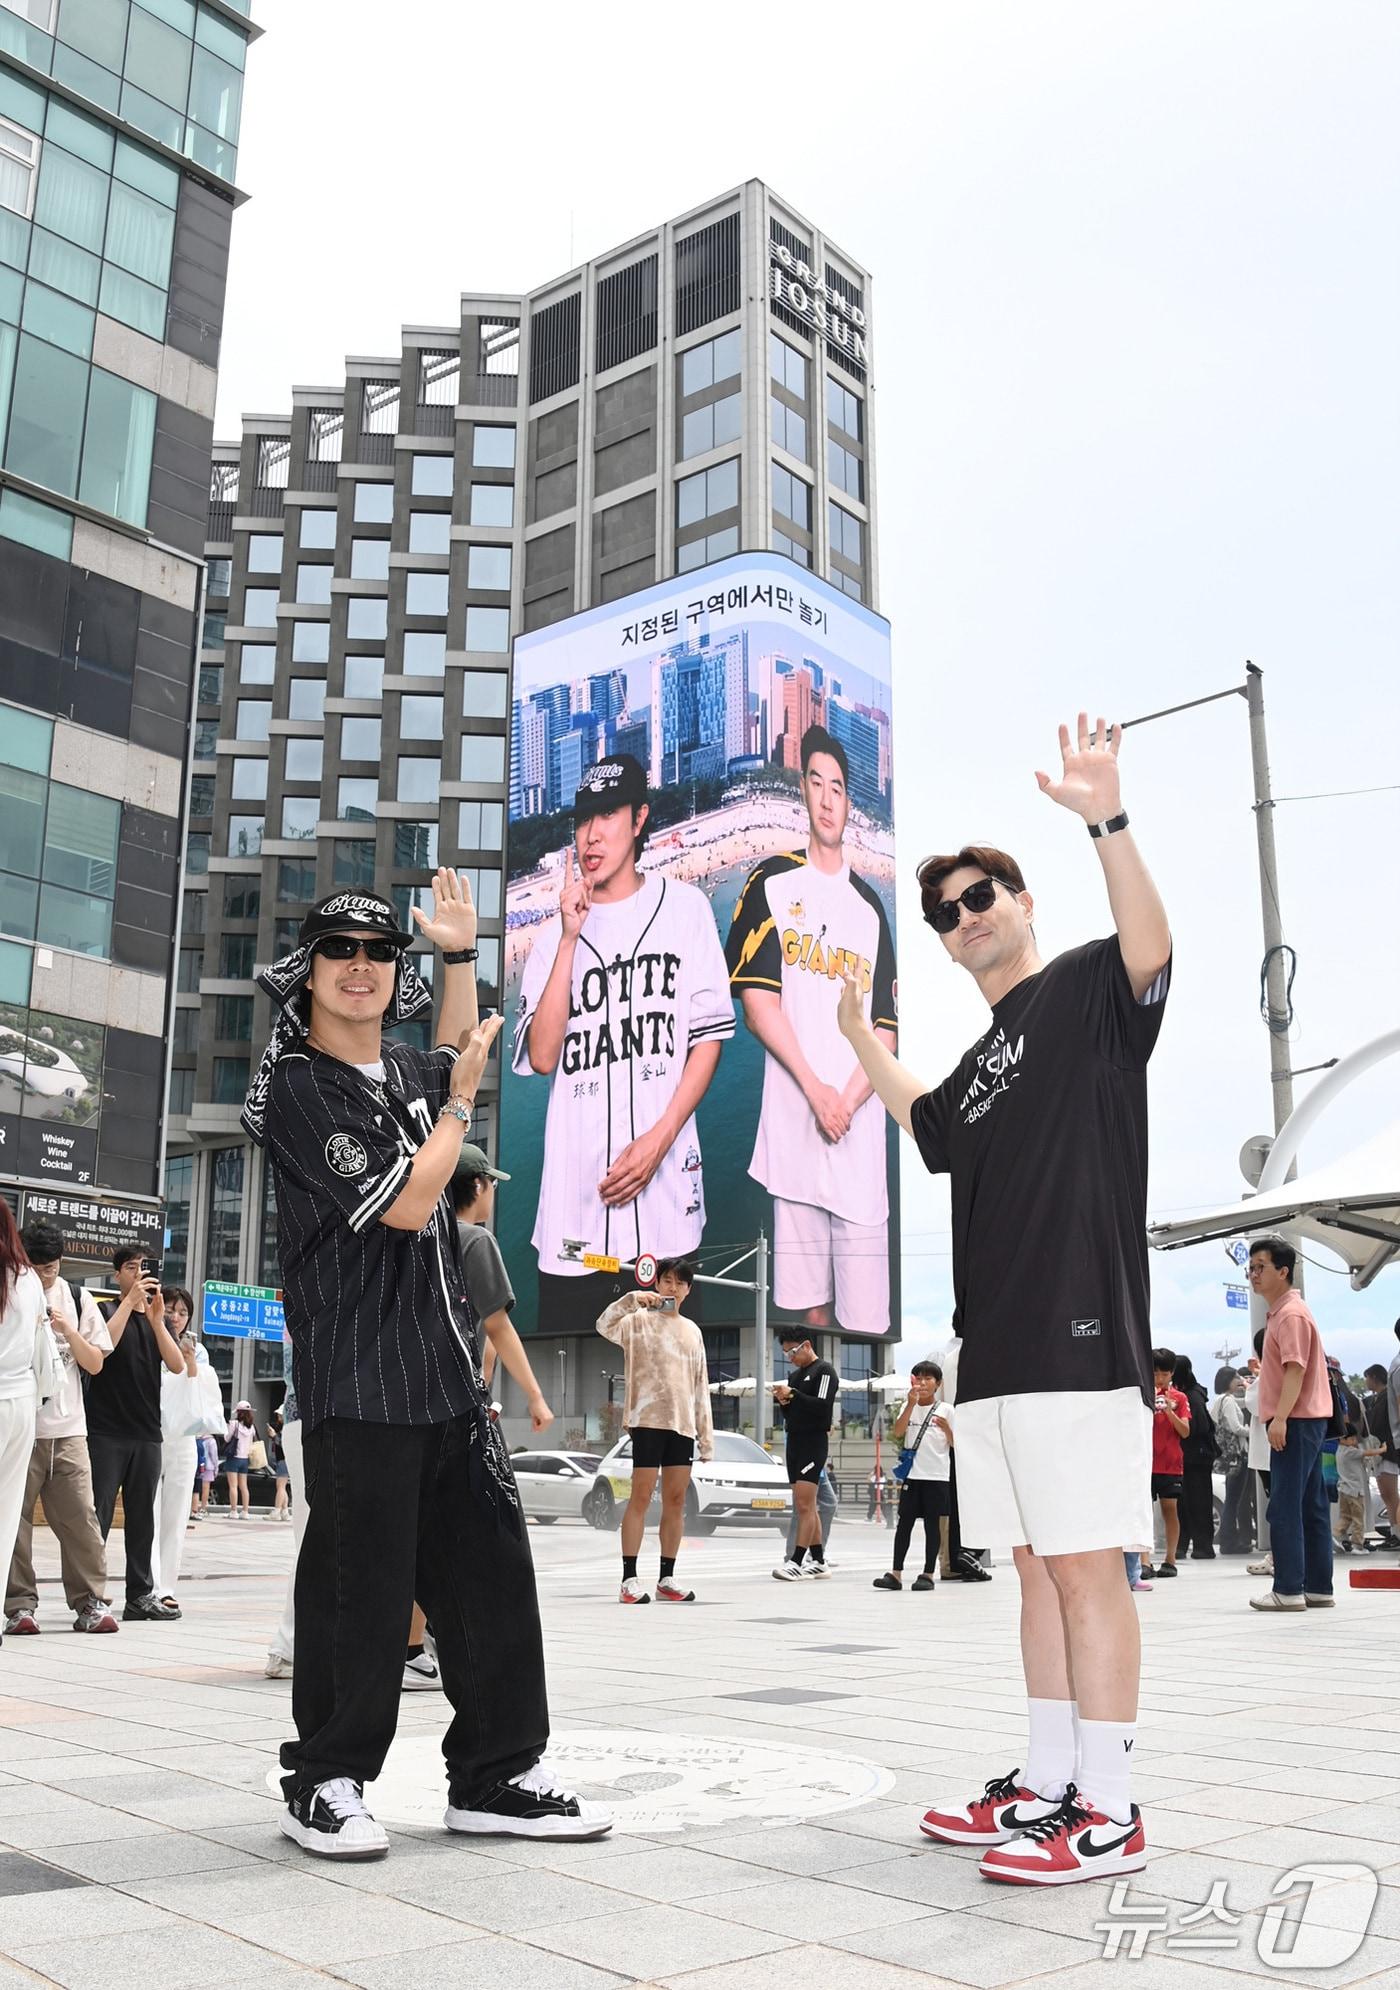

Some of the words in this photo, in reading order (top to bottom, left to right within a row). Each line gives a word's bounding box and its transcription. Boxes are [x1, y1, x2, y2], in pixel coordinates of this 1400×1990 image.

[776, 245, 866, 327] GRAND
[621, 609, 679, 646] 지정된
[686, 585, 793, 624] 구역에서만
[799, 597, 828, 635] 놀기
[320, 894, 390, 915] Giants
[562, 1011, 675, 1076] GIANTS
[42, 1133, 75, 1149] Whiskey
[47, 1146, 68, 1158] Wine
[40, 1158, 73, 1171] Cocktail
[339, 1153, 365, 1172] GIANTS
[78, 1171, 90, 1182] 2F
[26, 1196, 58, 1215] 새로운
[100, 1207, 129, 1225] 이끌어
[130, 1212, 162, 1230] 갑니다.
[641, 1263, 653, 1276] 50
[220, 1299, 250, 1313] 중동2로
[247, 1329, 266, 1338] 250m
